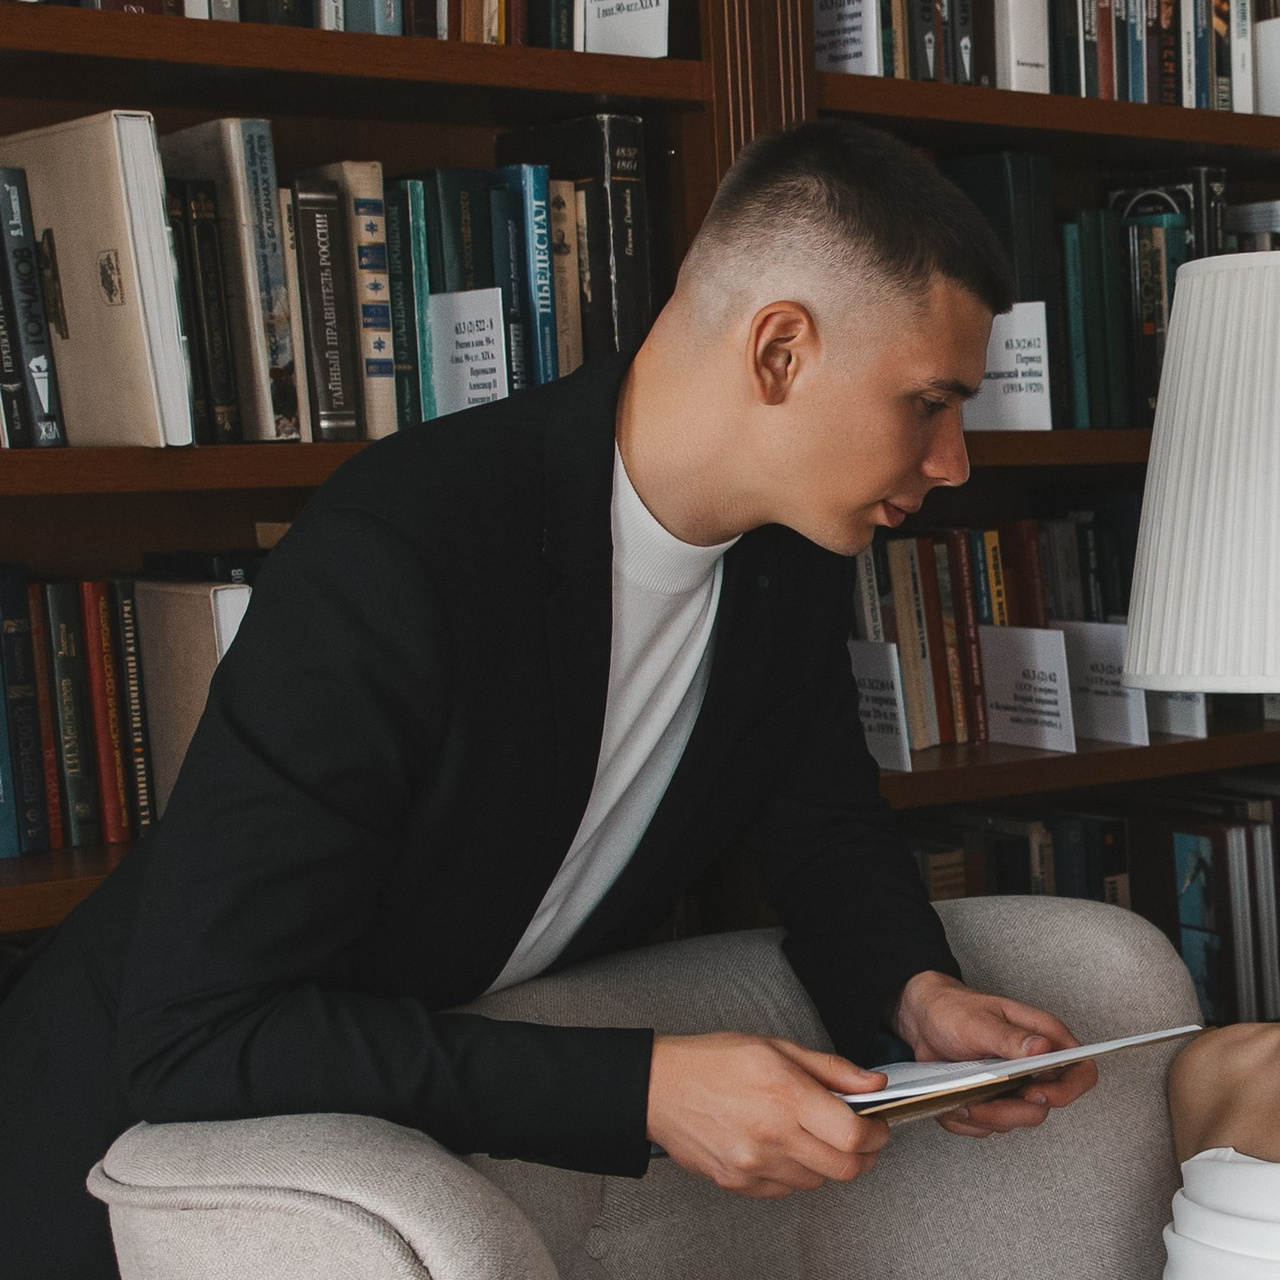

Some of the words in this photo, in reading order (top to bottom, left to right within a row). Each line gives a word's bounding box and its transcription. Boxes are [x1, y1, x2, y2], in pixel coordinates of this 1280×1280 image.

[262, 178, 276, 239] БАЛКАНАХ
[388, 205, 402, 273] ПРОШЛОМ
[315, 214, 331, 265] РОССИИ
[534, 200, 551, 313] ПЬЕДЕСТАЛ
[14, 247, 45, 345] ГОРЧАКОВ
[321, 269, 338, 345] ПРАВИТЕЛЬ
[392, 282, 407, 347] ДАЛЕКОМ
[325, 350, 344, 407] ТАЙНЫЙ
[1016, 354, 1041, 366] Период
[99, 601, 111, 652] ПРЕДАТЕЛЯ
[103, 655, 115, 695] ОДНОГО
[107, 698, 119, 744] ИСТОРИЯ
[13, 706, 39, 802] КЕРЕНСКИЙ
